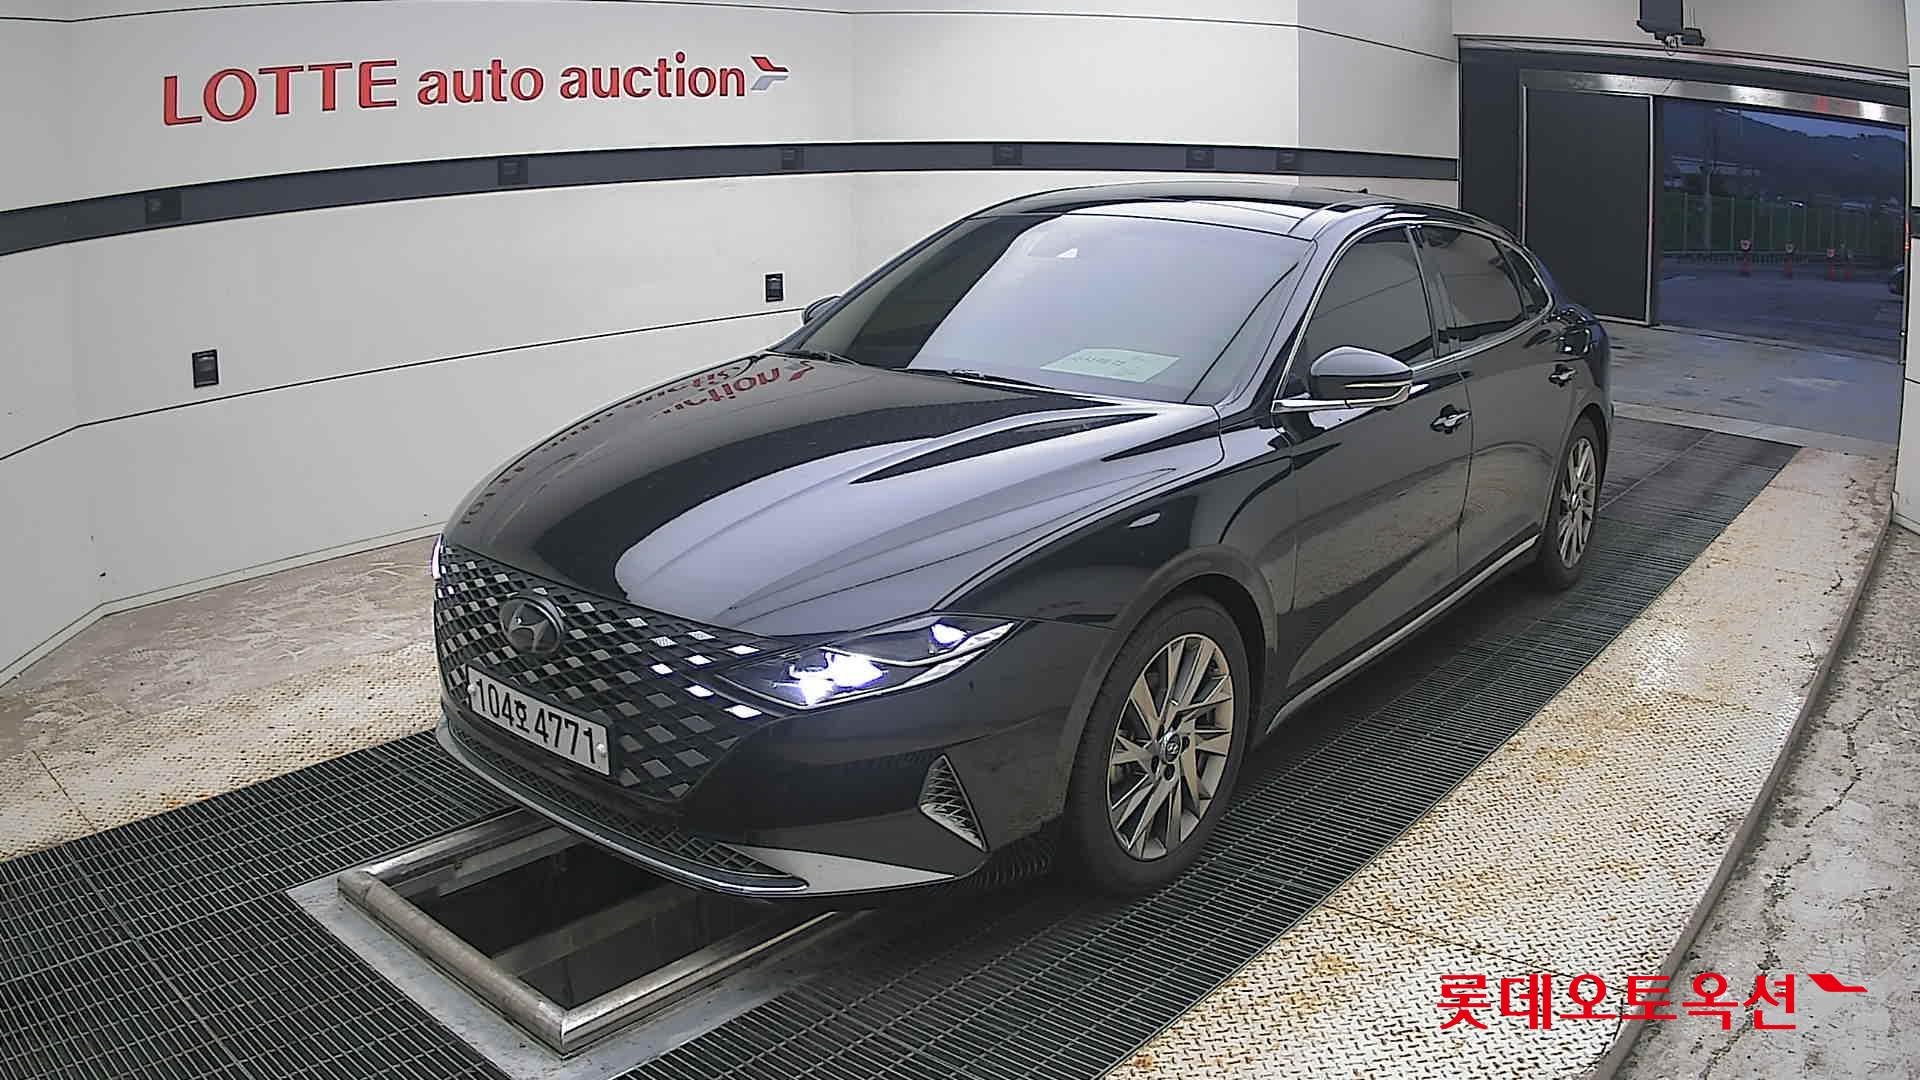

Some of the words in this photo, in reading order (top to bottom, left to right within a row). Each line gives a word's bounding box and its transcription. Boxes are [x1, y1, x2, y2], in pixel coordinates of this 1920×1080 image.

[163, 59, 398, 126] LOTTE
[417, 58, 544, 104] auto
[560, 51, 746, 98] auction
[534, 707, 596, 765] 4771
